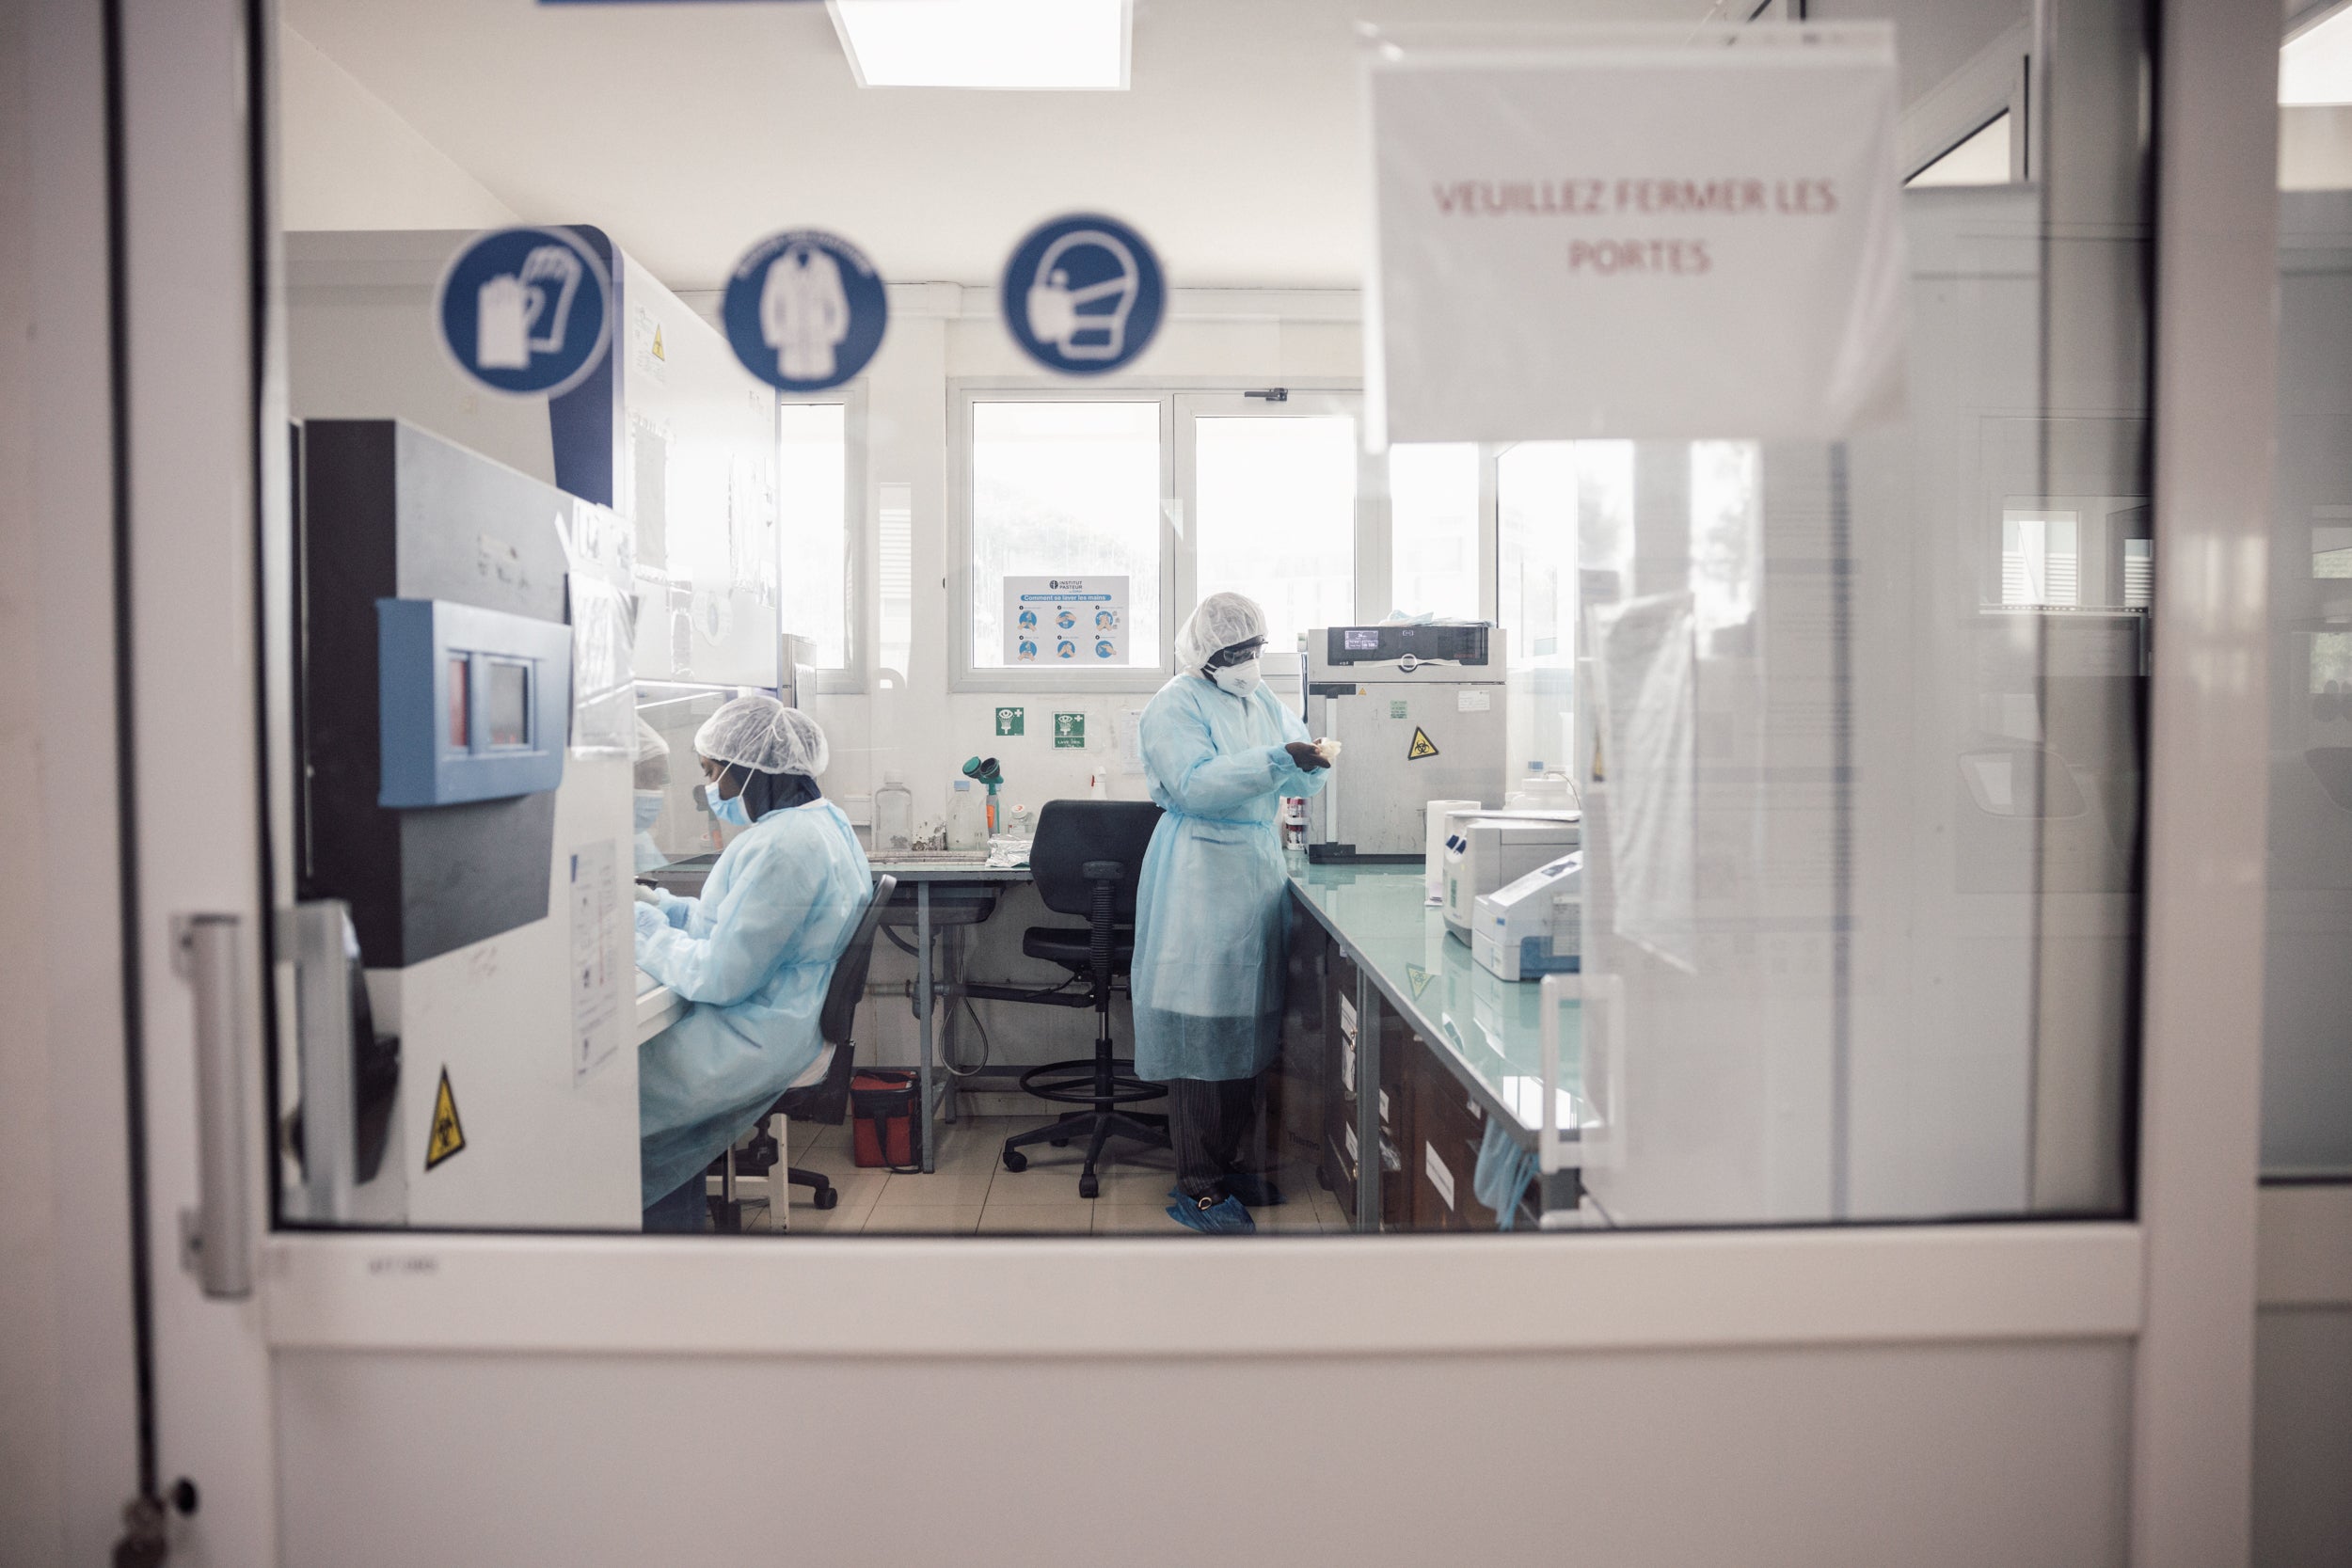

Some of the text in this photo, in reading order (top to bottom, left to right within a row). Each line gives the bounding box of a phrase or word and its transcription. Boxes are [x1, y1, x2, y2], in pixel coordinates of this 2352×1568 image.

[1432, 178, 1837, 216] VEUILLEZ FERMER LES
[1568, 238, 1710, 275] PORTES
